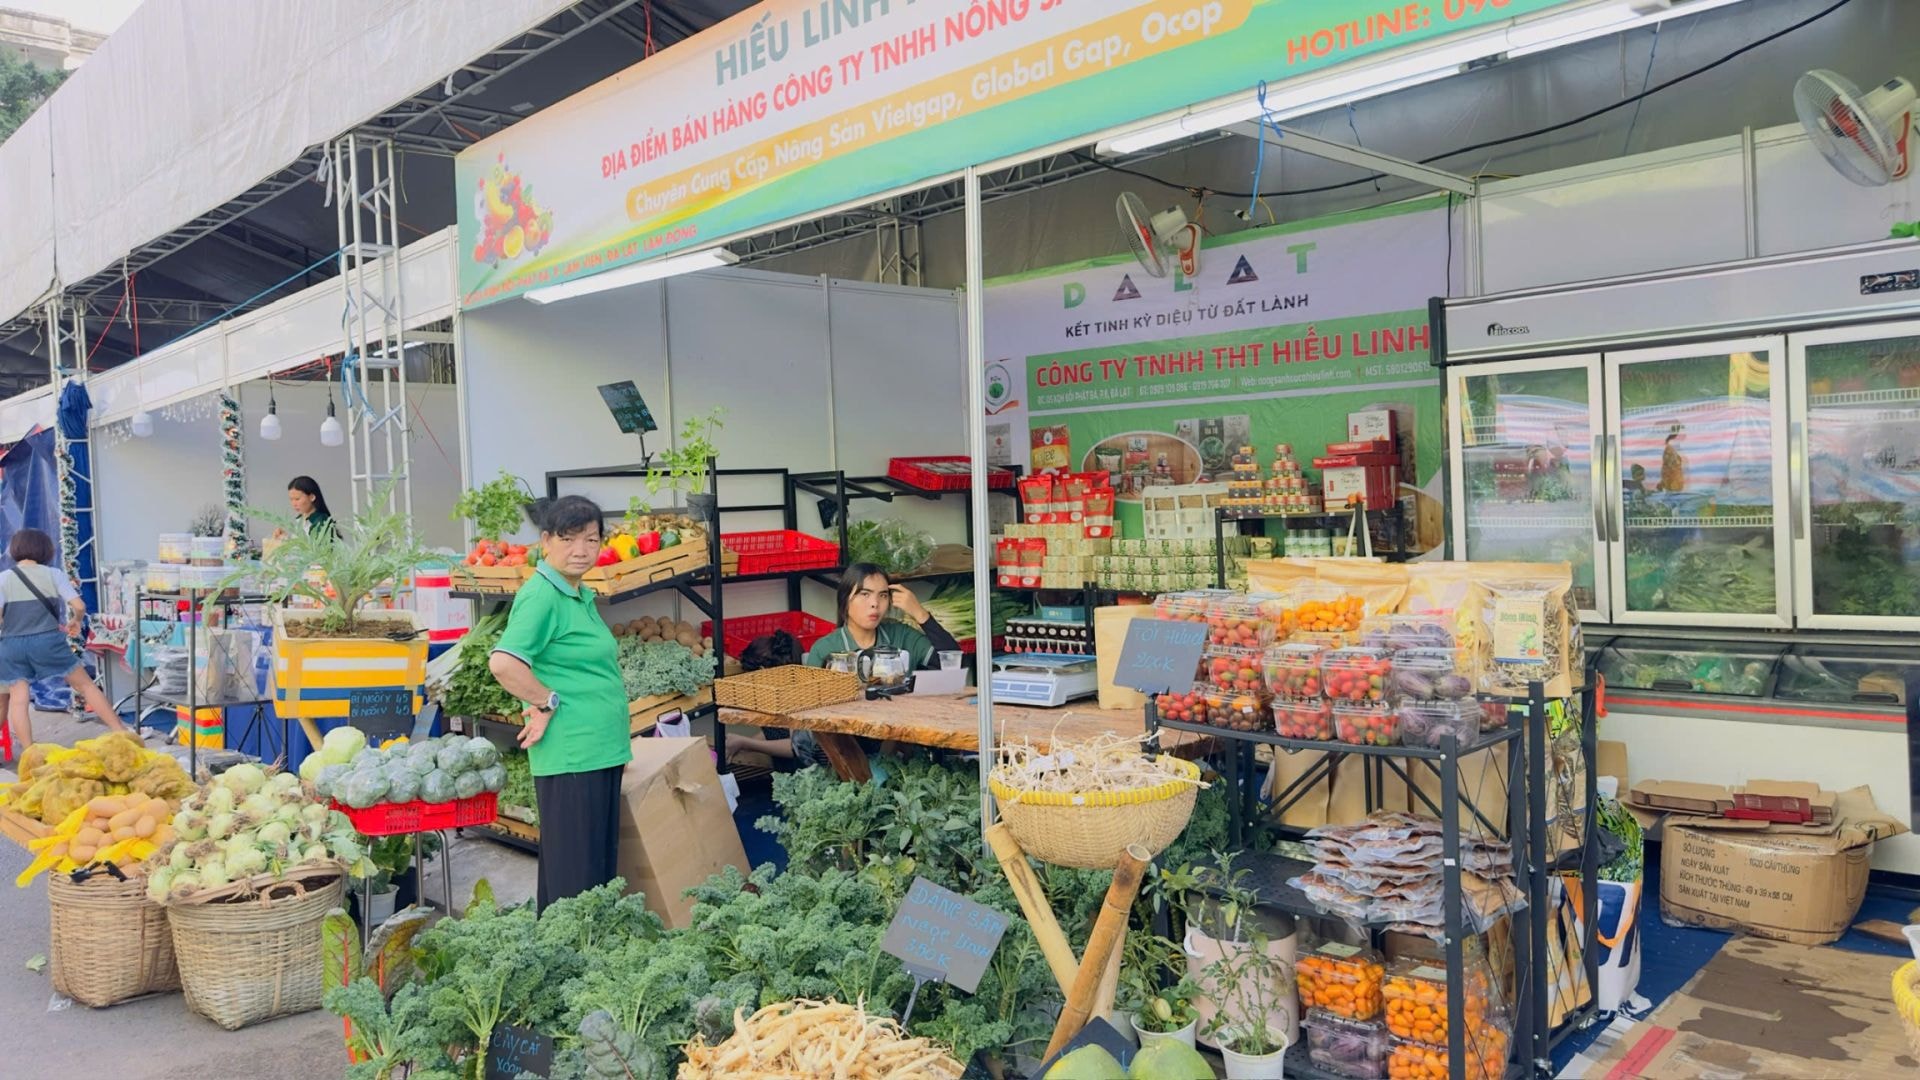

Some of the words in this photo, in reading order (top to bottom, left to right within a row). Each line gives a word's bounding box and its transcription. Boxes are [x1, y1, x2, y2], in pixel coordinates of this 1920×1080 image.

[715, 11, 789, 86] HIẾU
[1286, 3, 1431, 65] HOTLINE:
[601, 149, 627, 180] ĐỊA
[630, 127, 669, 168] ĐIỂM
[671, 115, 708, 152] BÁN
[712, 92, 767, 135] HÀNG
[773, 65, 833, 111] CÔNG
[838, 51, 864, 85] TY
[870, 23, 937, 74] TNHH
[944, 0, 1030, 47] NÔNG
[634, 183, 688, 214] Chuyên
[690, 167, 731, 194] Cung
[735, 151, 769, 180] Cấp
[774, 134, 823, 167] Nông
[971, 47, 1054, 100] Global
[1062, 34, 1132, 71] Gap,
[1141, 2, 1223, 44] Ocop
[1065, 319, 1090, 338] KẾT
[1094, 318, 1129, 334] TINH
[1156, 309, 1193, 326] DIỆU
[1198, 305, 1219, 321] TỪ
[1223, 298, 1256, 318] ĐẤT
[1261, 294, 1309, 313] LÀNH
[1035, 360, 1094, 388] CÔNG
[1098, 358, 1128, 381] TY
[1133, 351, 1204, 378] TNHH
[1211, 343, 1264, 370] THT
[1271, 325, 1343, 366] HIẾU
[1352, 324, 1431, 358] LINH
[1735, 898, 1750, 909] NAM
[1782, 892, 1793, 902] CM
